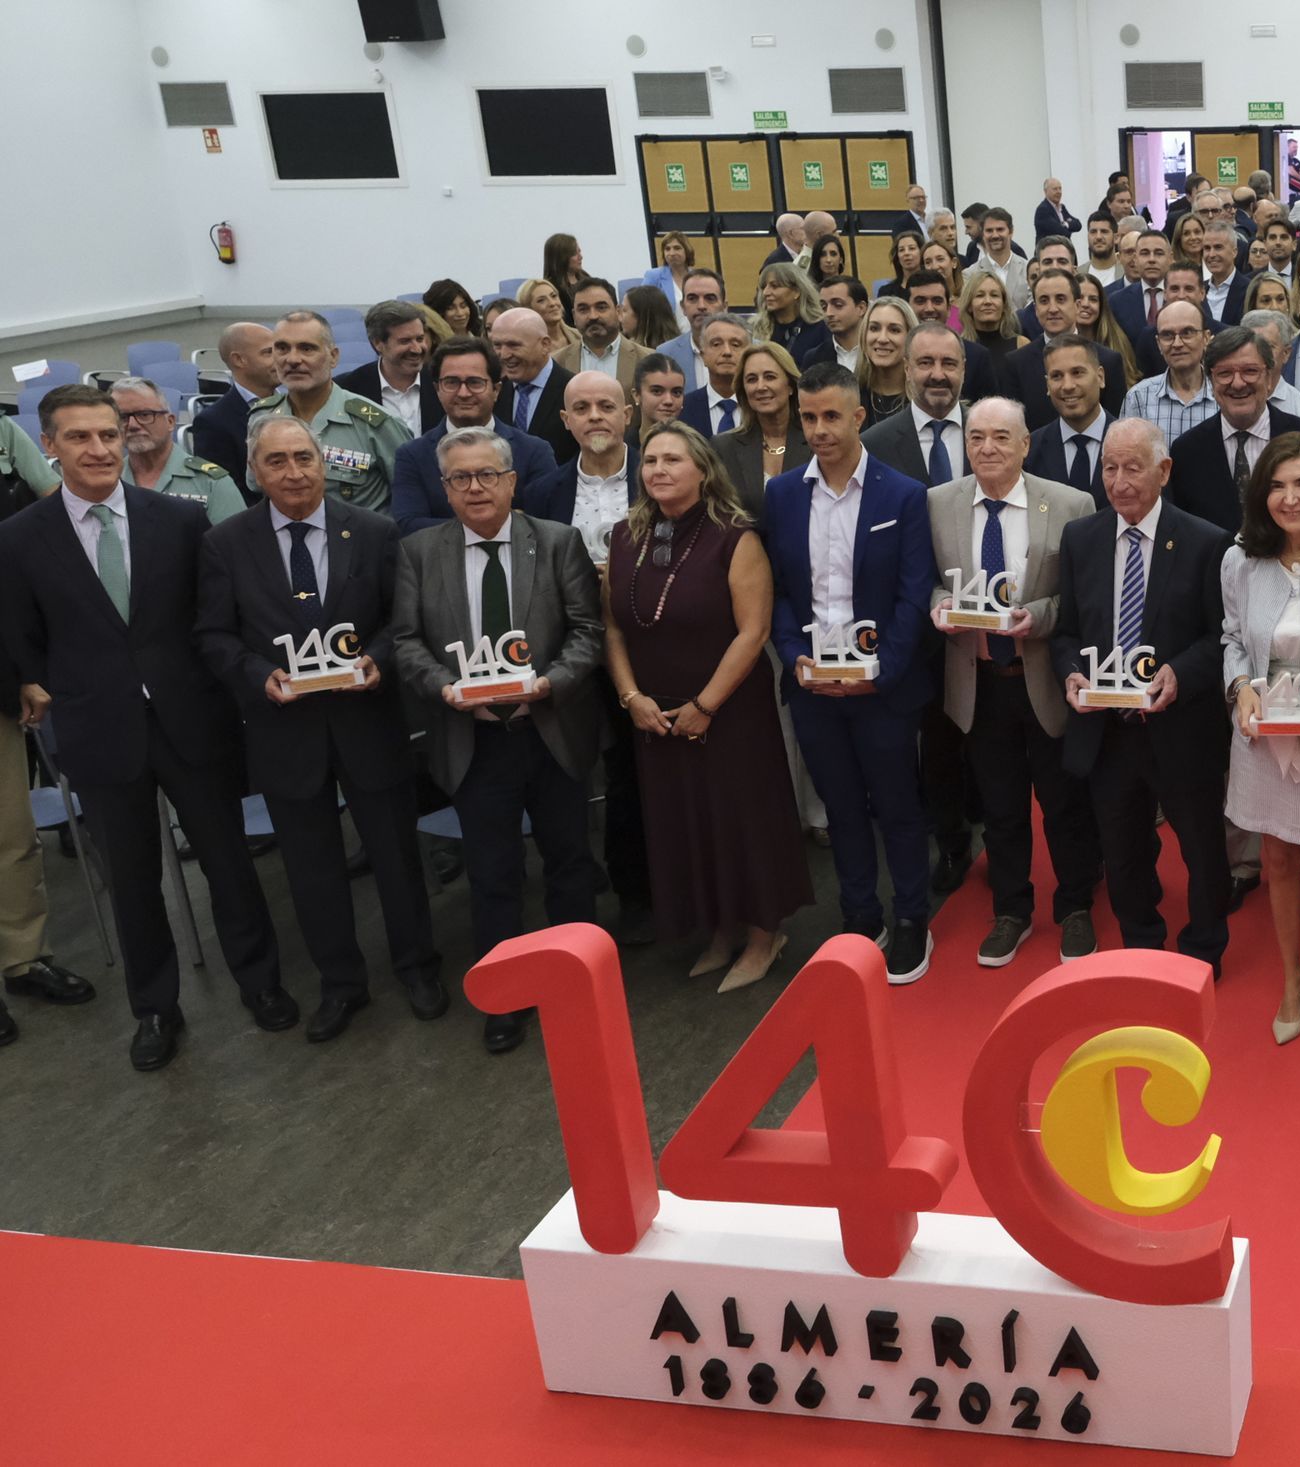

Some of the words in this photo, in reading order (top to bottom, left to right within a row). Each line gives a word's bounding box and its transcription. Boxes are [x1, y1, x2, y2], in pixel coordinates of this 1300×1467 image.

[649, 1289, 1100, 1381] ALMERÍA
[662, 1354, 827, 1410] 1886
[908, 1376, 1092, 1435] 2026
